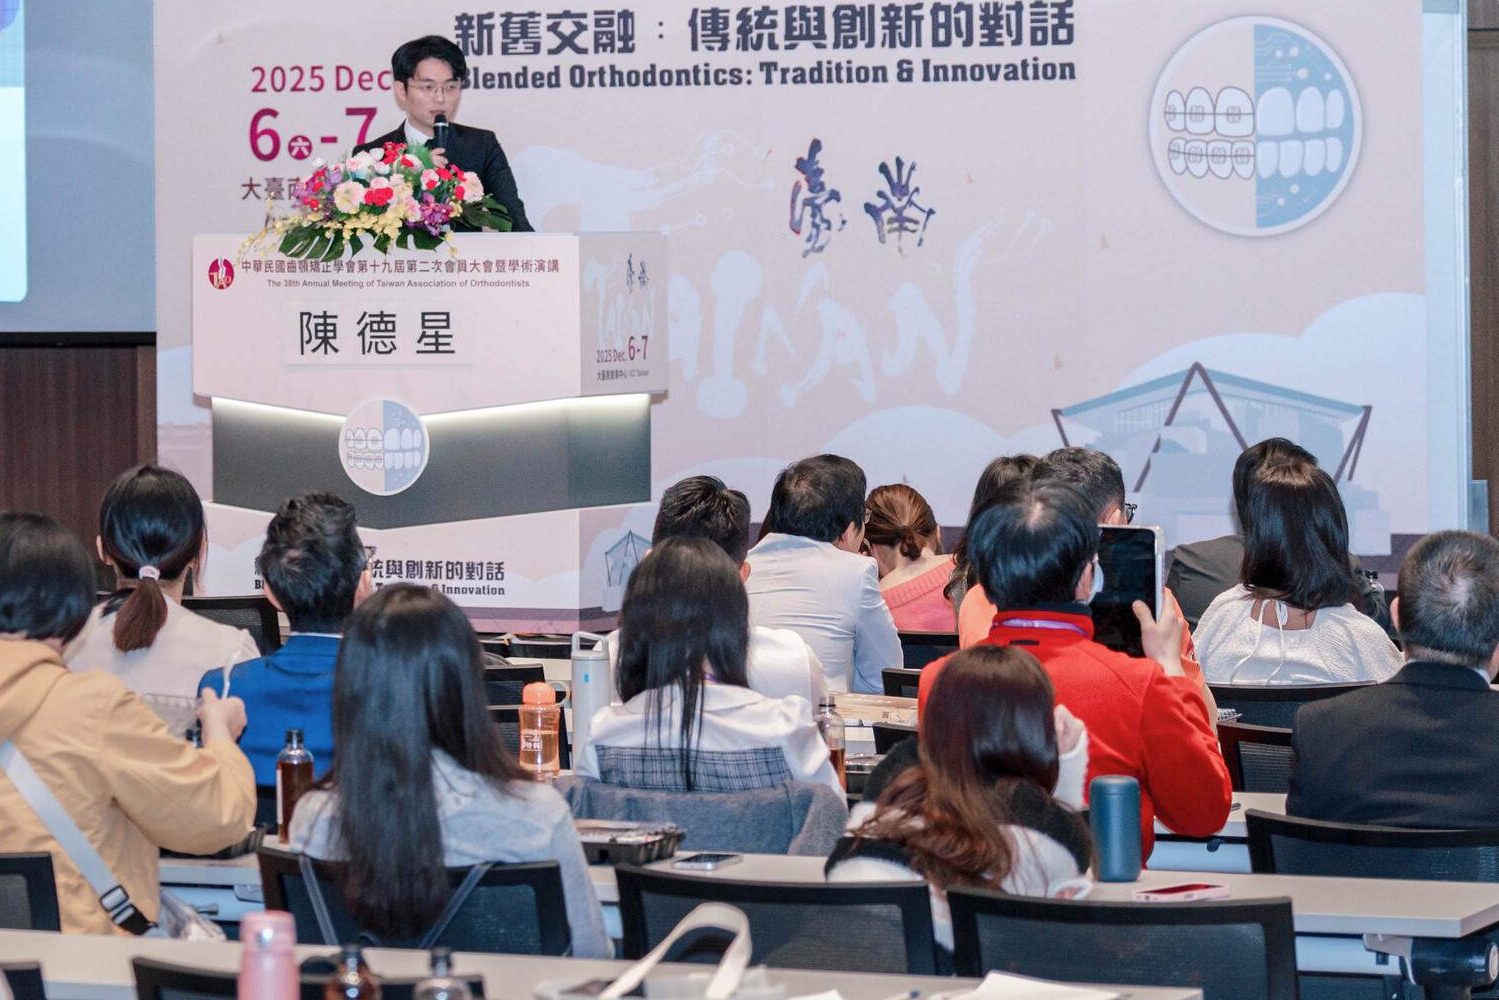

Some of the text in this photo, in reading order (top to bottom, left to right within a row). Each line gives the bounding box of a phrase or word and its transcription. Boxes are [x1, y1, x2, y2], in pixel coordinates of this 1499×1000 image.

[251, 65, 325, 93] 2025
[570, 62, 752, 88] Orthodontics:
[759, 60, 888, 85] Tradition
[897, 59, 914, 82] &
[922, 57, 1076, 82] Innovation
[268, 279, 530, 289] The 38th Annual Meeting of Taiwan Association of Orthodontists
[300, 310, 456, 356] 陳德星
[596, 349, 613, 363] 2025
[628, 335, 649, 361] 6-7
[442, 584, 505, 595] Innovation
